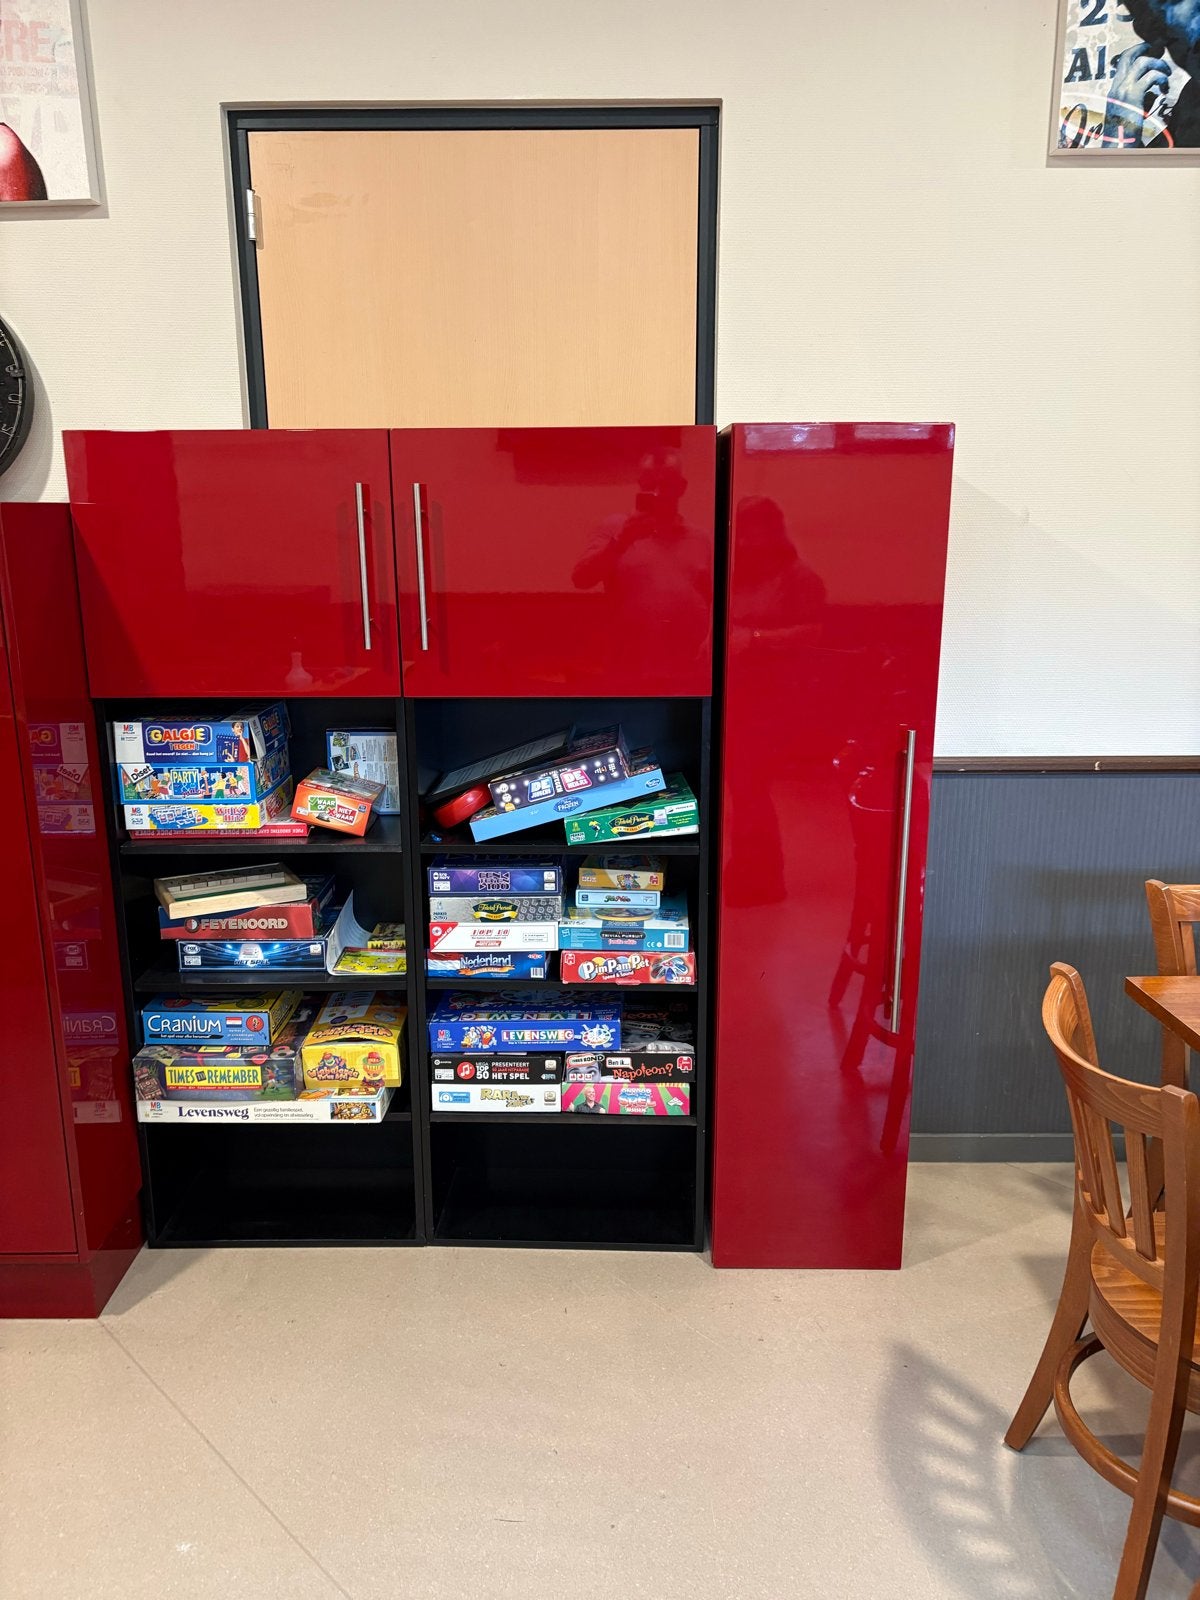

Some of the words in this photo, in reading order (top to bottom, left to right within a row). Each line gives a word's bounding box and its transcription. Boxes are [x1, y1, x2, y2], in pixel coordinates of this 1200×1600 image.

[150, 728, 206, 742] GALGJE
[131, 765, 151, 780] Diset
[173, 771, 197, 783] PARTY
[563, 770, 583, 784] DE
[531, 779, 551, 793] DE
[336, 813, 354, 821] WAAR
[339, 807, 352, 815] NIET
[201, 918, 288, 930] FEYENOORD
[460, 953, 512, 969] Nederland
[438, 1030, 450, 1038] MB
[503, 1030, 573, 1041] LEVENSWEG
[584, 1054, 605, 1062] BOND
[168, 1069, 195, 1084] TIMES
[207, 1069, 259, 1084] REMEMBER
[476, 1071, 490, 1079] 50
[491, 1072, 507, 1080] HET
[510, 1072, 530, 1080] SPEL
[612, 1062, 674, 1081] Napoleon?
[480, 1087, 518, 1101] RARA
[178, 1106, 249, 1120] Levensweg
